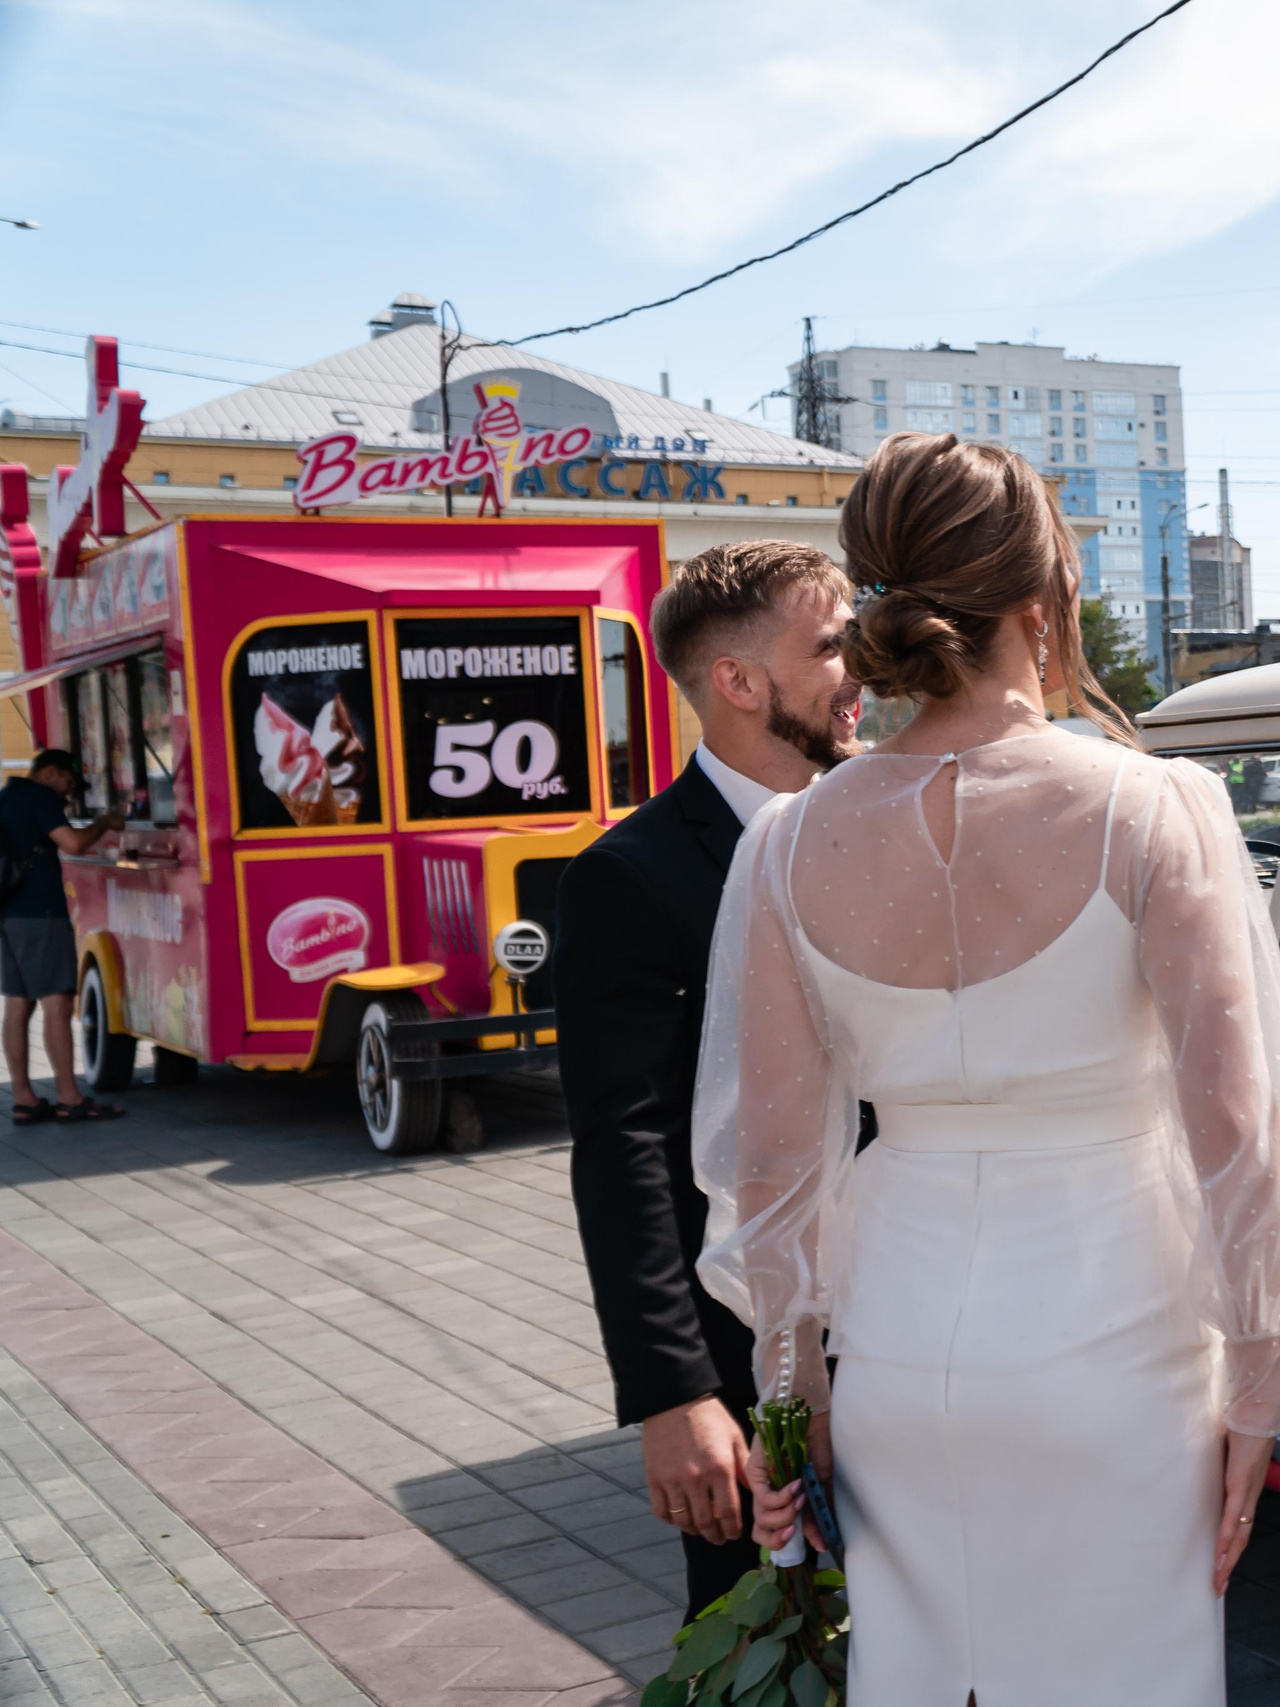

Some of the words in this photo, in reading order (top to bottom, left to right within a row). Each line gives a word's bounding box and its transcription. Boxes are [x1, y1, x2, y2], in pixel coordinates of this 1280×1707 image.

[468, 459, 725, 500] АССАЖ
[248, 644, 364, 676] МОРОЖЕНОЕ
[401, 645, 577, 680] МОРОЖЕНОЕ
[429, 719, 559, 798] 50
[521, 776, 568, 801] руб.
[505, 944, 543, 957] DLAA
